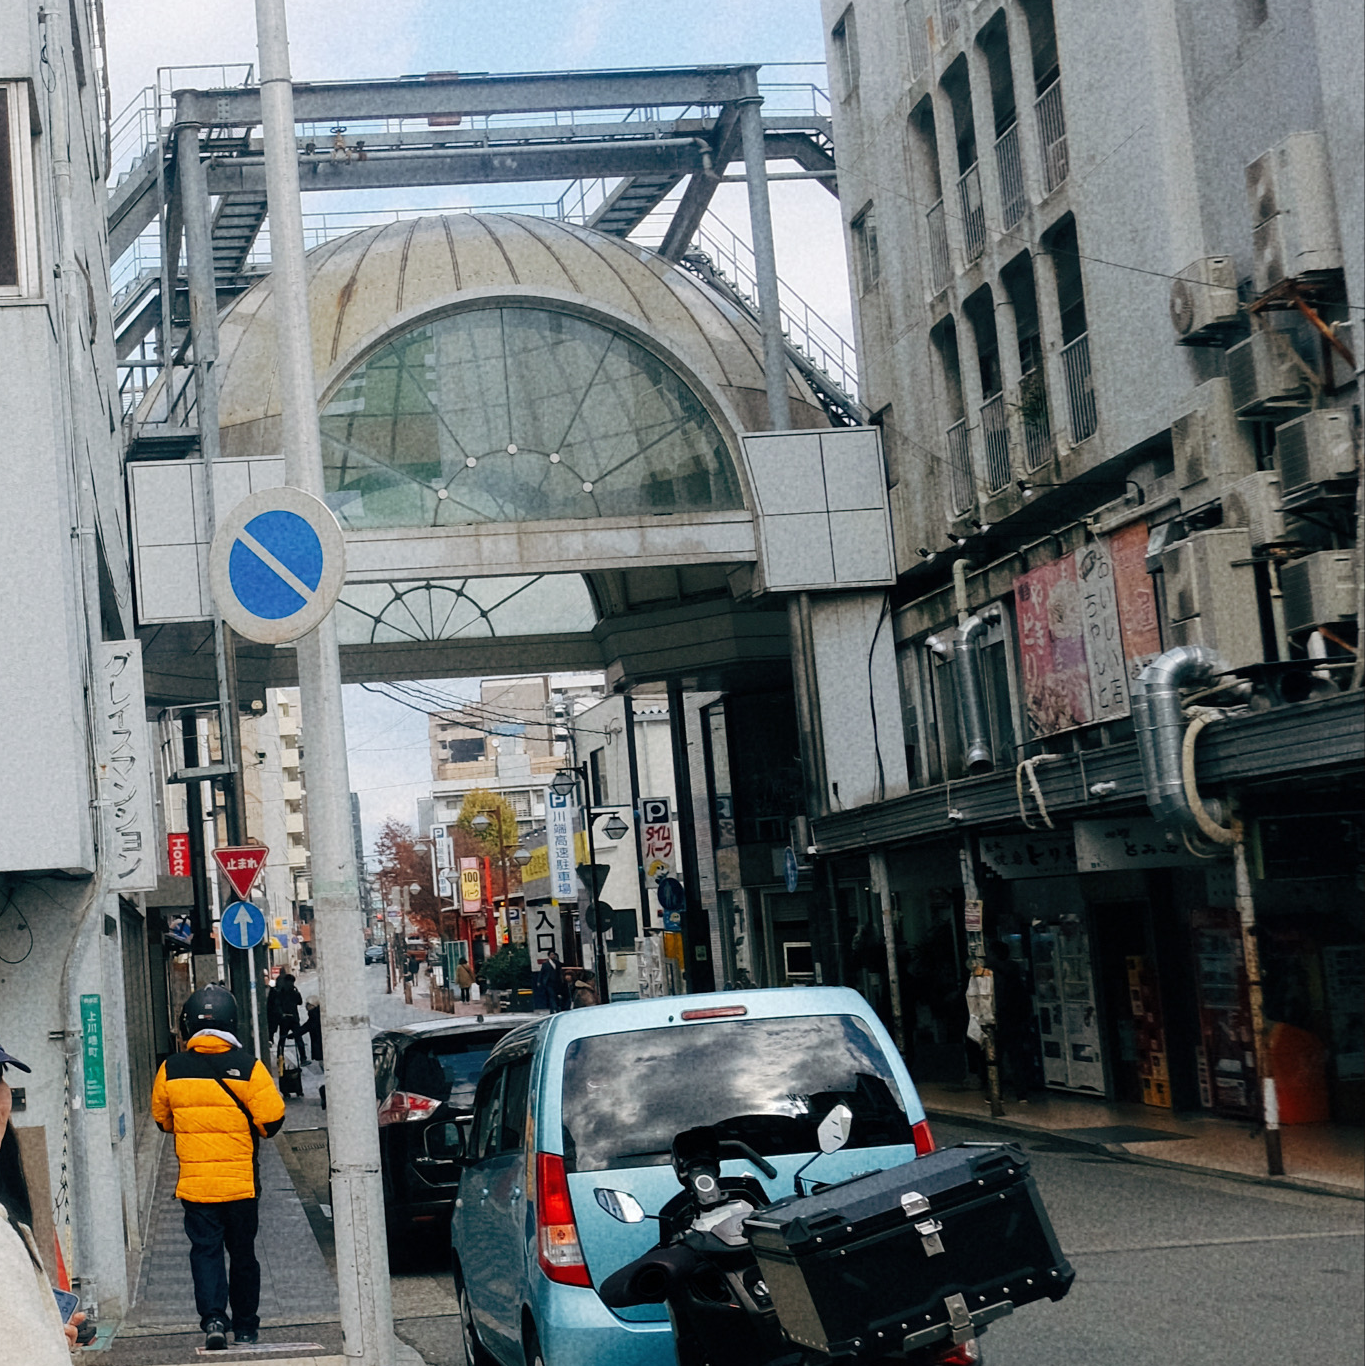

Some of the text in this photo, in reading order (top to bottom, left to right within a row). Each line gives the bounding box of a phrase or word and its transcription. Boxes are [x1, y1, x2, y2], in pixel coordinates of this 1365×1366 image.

[104, 650, 143, 880] グレイスマンション
[645, 825, 671, 842] タイム
[226, 857, 258, 871] 止まれ
[553, 811, 572, 895] 川端高速駐車場
[463, 871, 478, 883] 100
[535, 911, 555, 953] 入口
